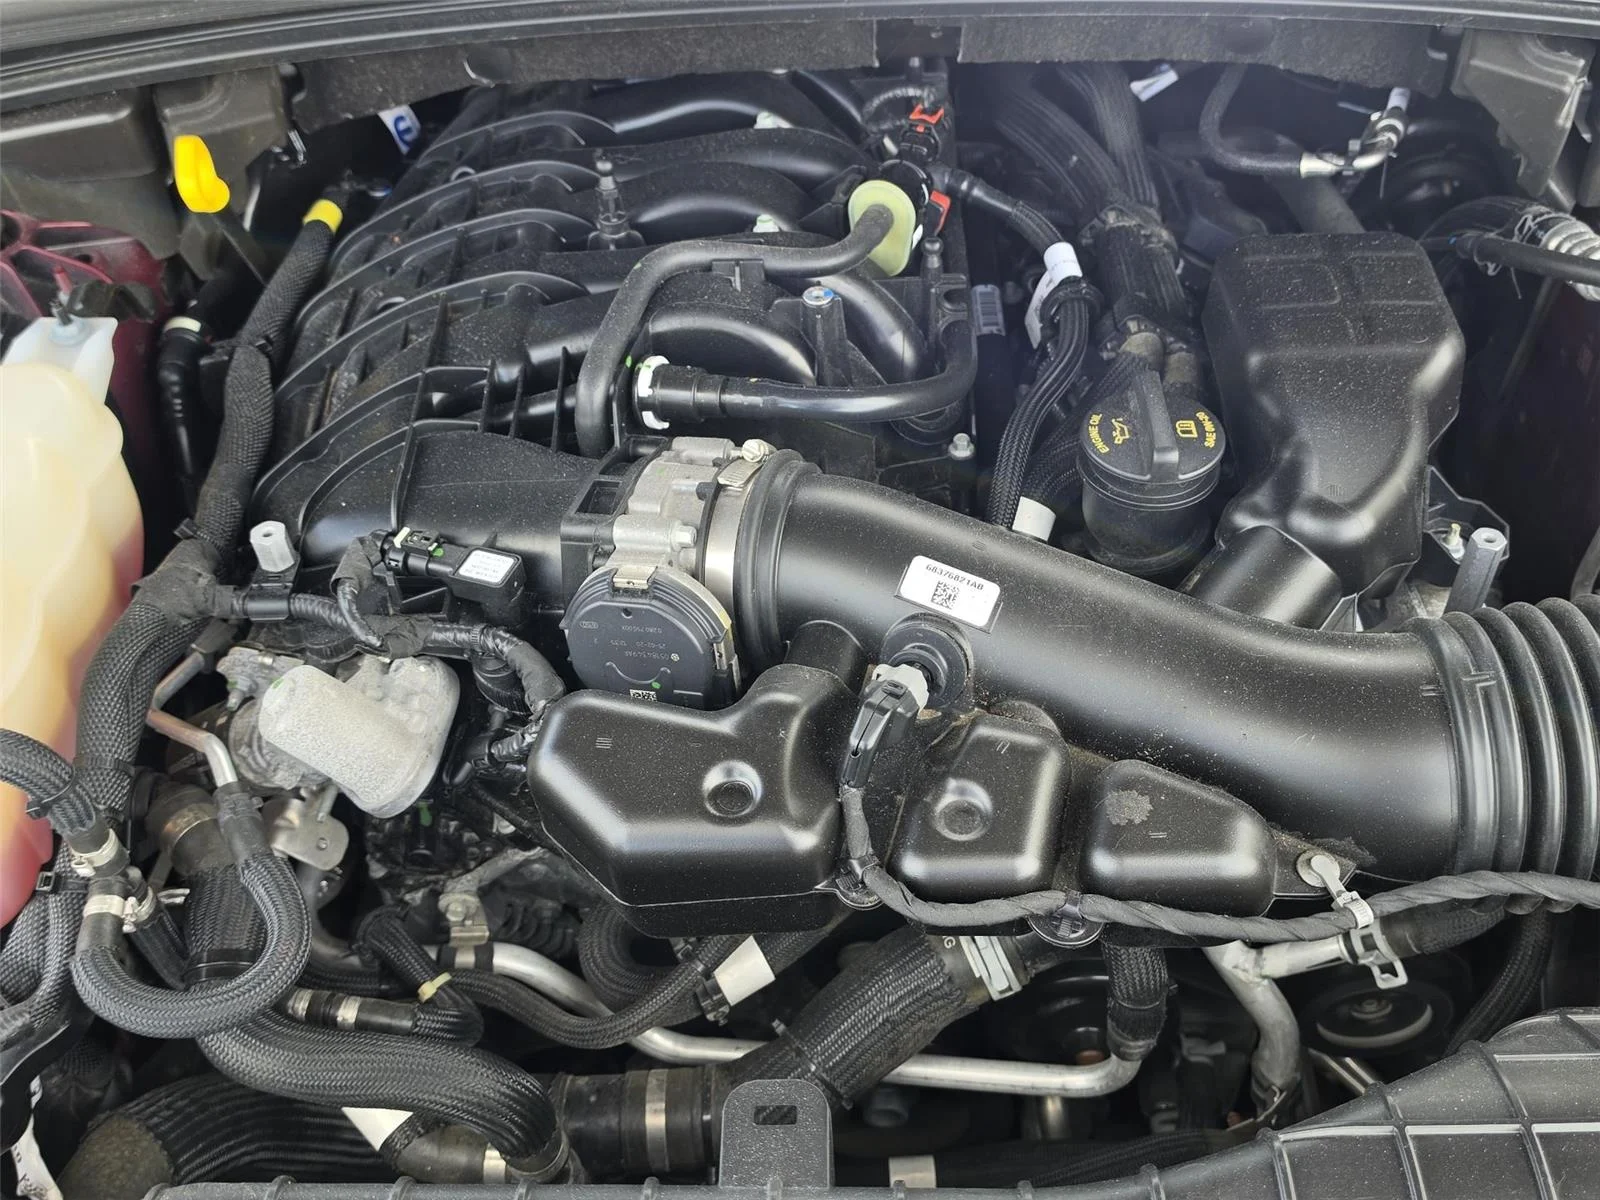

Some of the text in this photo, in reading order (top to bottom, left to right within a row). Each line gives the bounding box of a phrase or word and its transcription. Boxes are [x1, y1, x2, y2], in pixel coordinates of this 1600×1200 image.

[1088, 413, 1110, 454] ENGINE OIL
[1204, 432, 1216, 448] SAE
[925, 563, 984, 591] 68376821AB
